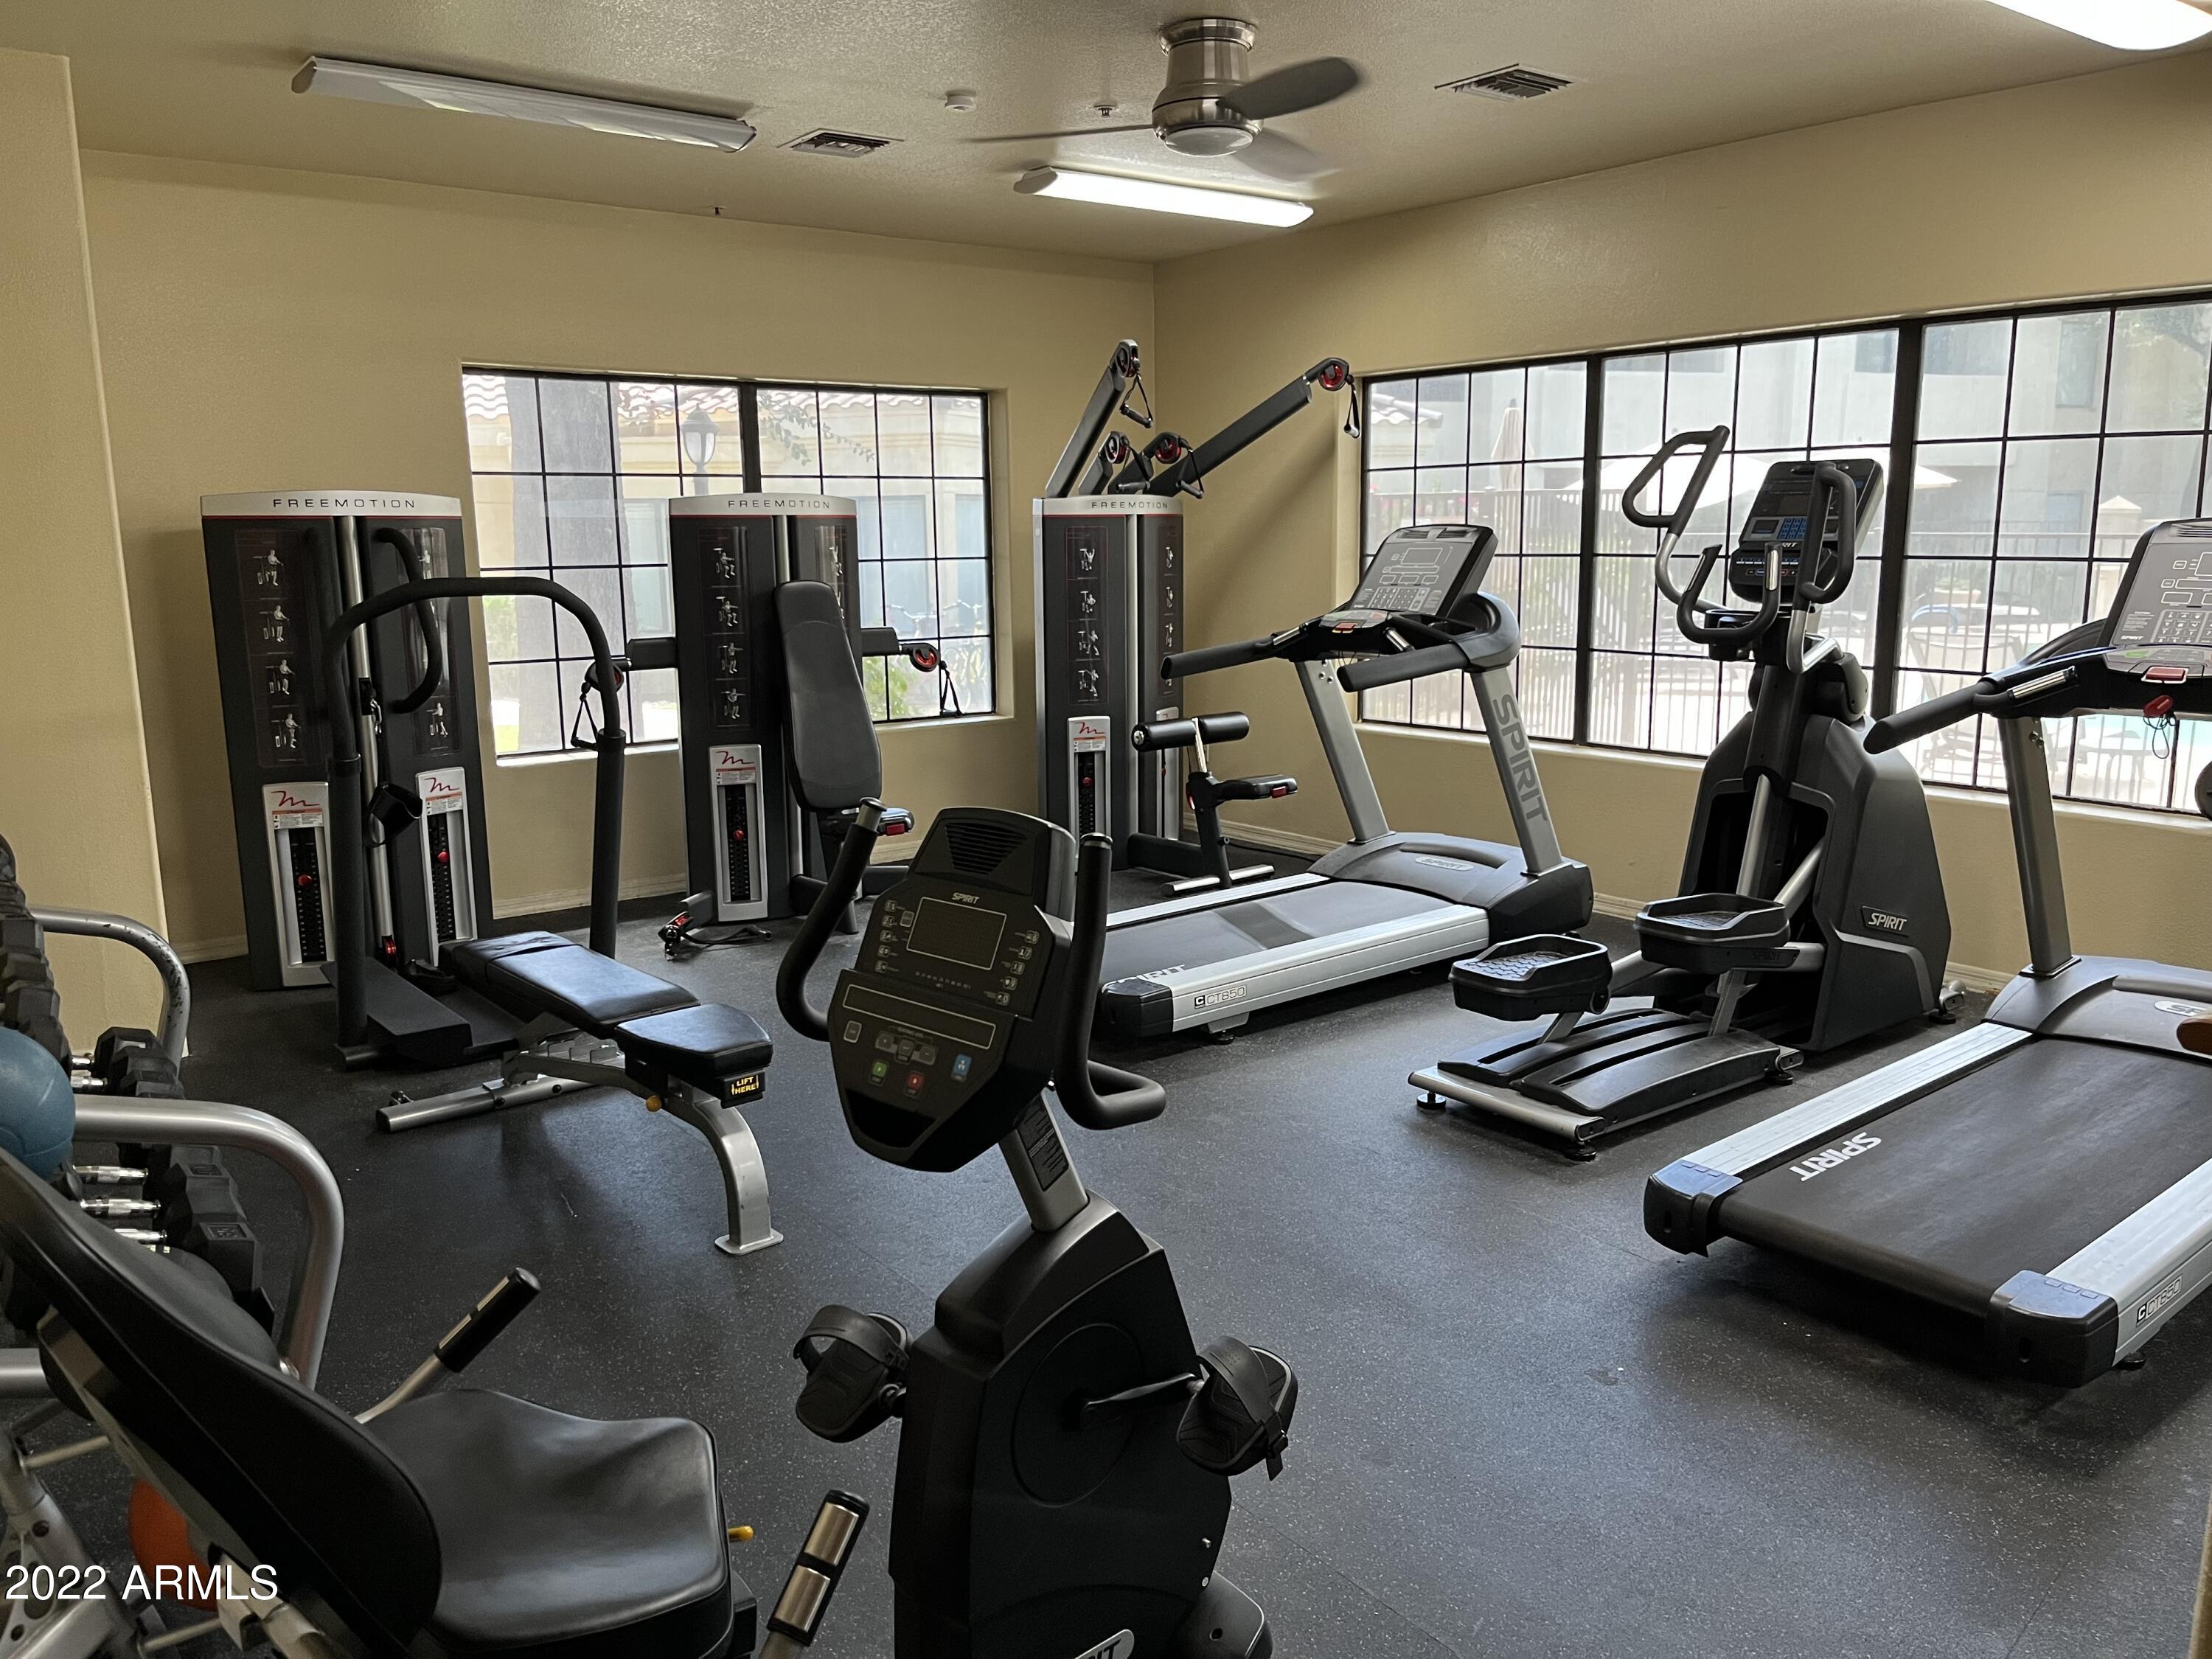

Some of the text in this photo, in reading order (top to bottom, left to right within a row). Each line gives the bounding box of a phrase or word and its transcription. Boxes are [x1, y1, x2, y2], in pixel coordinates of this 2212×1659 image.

[273, 498, 414, 508] FREEMOTION
[728, 500, 830, 509] FREEMOTION
[1493, 694, 1548, 822] SPIRIT
[952, 892, 980, 904] SPIRIT
[1868, 912, 1907, 931] SPIRIT
[1207, 987, 1245, 1004] CT850
[736, 1077, 754, 1086] LIFT
[735, 1084, 757, 1094] HERE
[1790, 1132, 1882, 1181] SPIRIT
